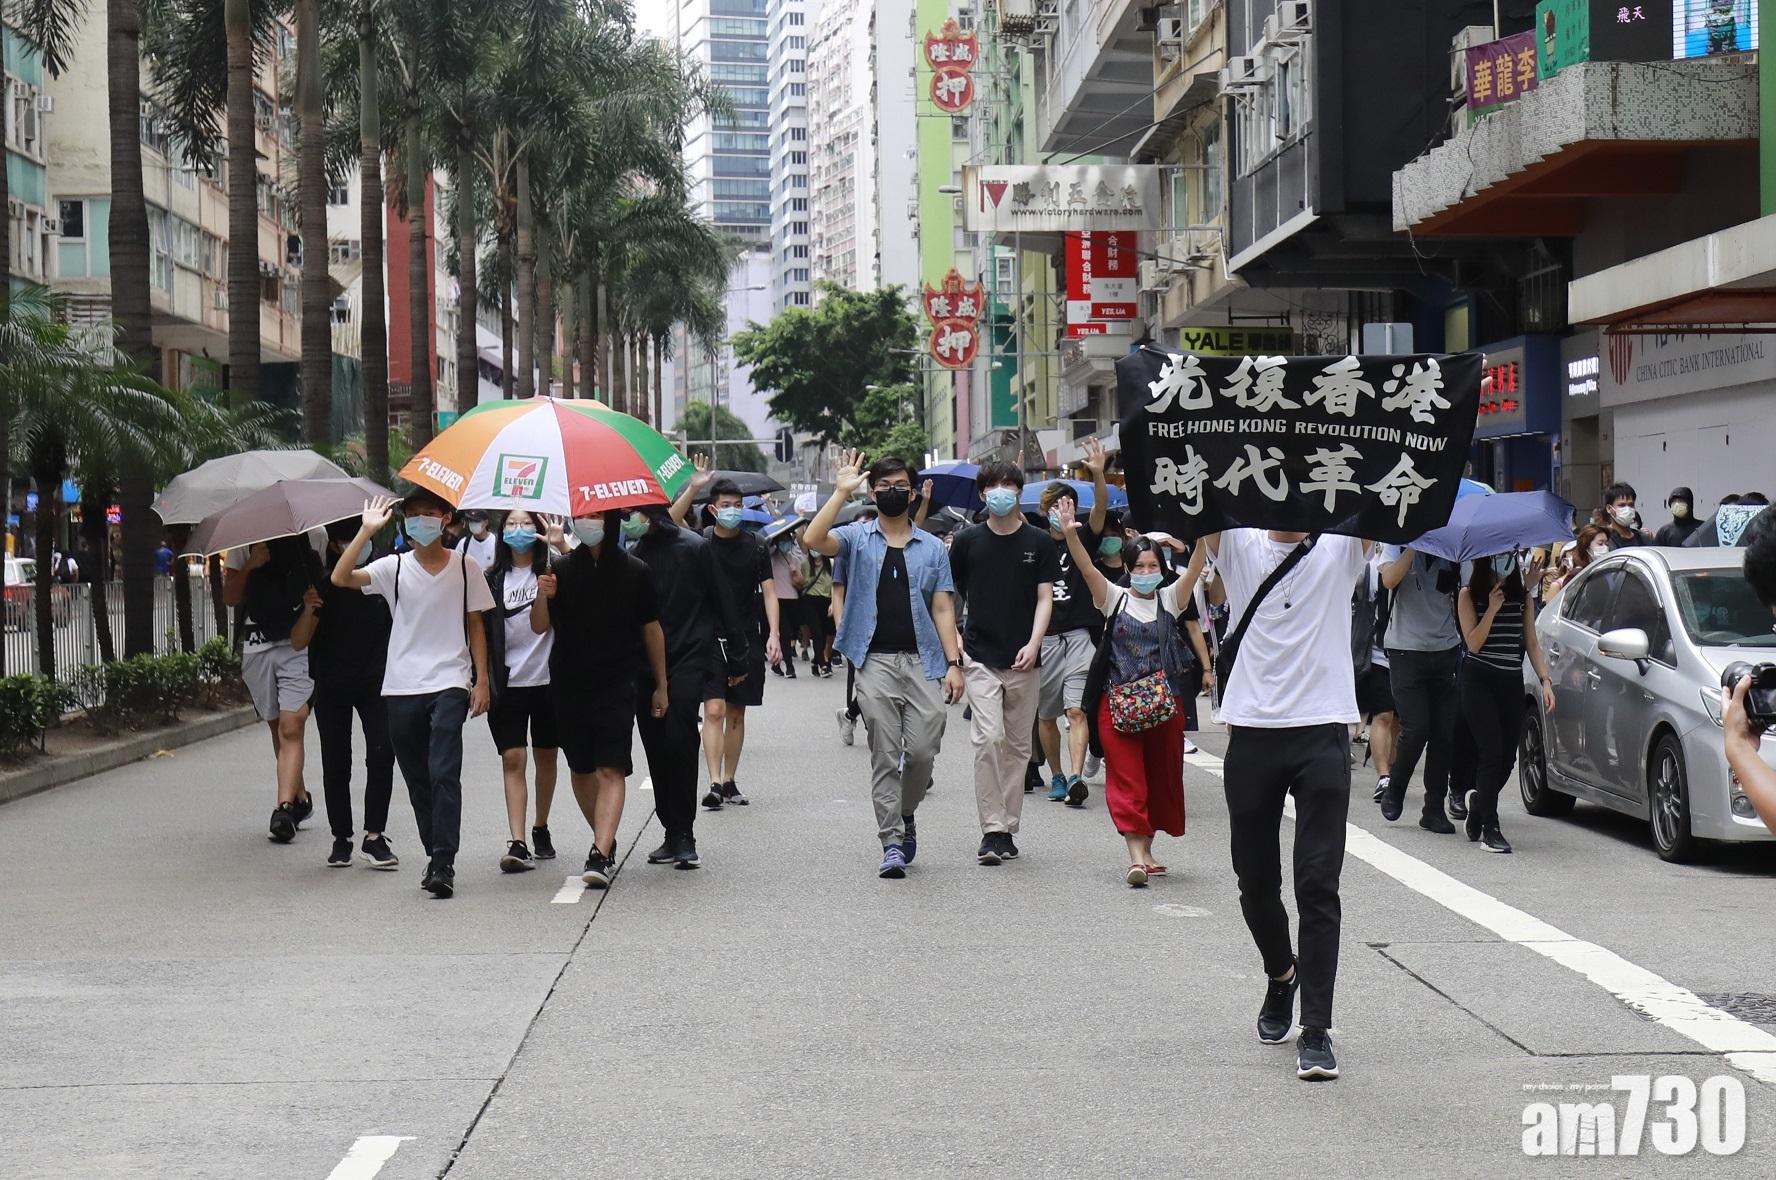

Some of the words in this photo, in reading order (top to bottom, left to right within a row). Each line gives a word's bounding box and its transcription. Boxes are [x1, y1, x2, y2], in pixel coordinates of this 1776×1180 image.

[1617, 6, 1645, 23] 飛天
[935, 72, 967, 106] 押
[1011, 208, 1143, 218] www.victoryhardware.com
[1107, 231, 1119, 271] 合財務
[936, 325, 972, 361] 押
[1184, 332, 1244, 351] YALE
[1636, 361, 1657, 383] CHINA
[1658, 358, 1678, 378] CITIC
[1679, 354, 1700, 374] BANK
[1701, 341, 1765, 370] INTERNATIONAL
[1144, 353, 1451, 425] 光復香港
[1149, 421, 1187, 438] FREE
[1186, 420, 1235, 434] HONG
[1238, 418, 1287, 433] KONG
[1295, 421, 1401, 444] REVOLUTION
[1404, 431, 1449, 452] NOW
[1150, 443, 1438, 529] 時代革命
[507, 587, 537, 603] NIKE
